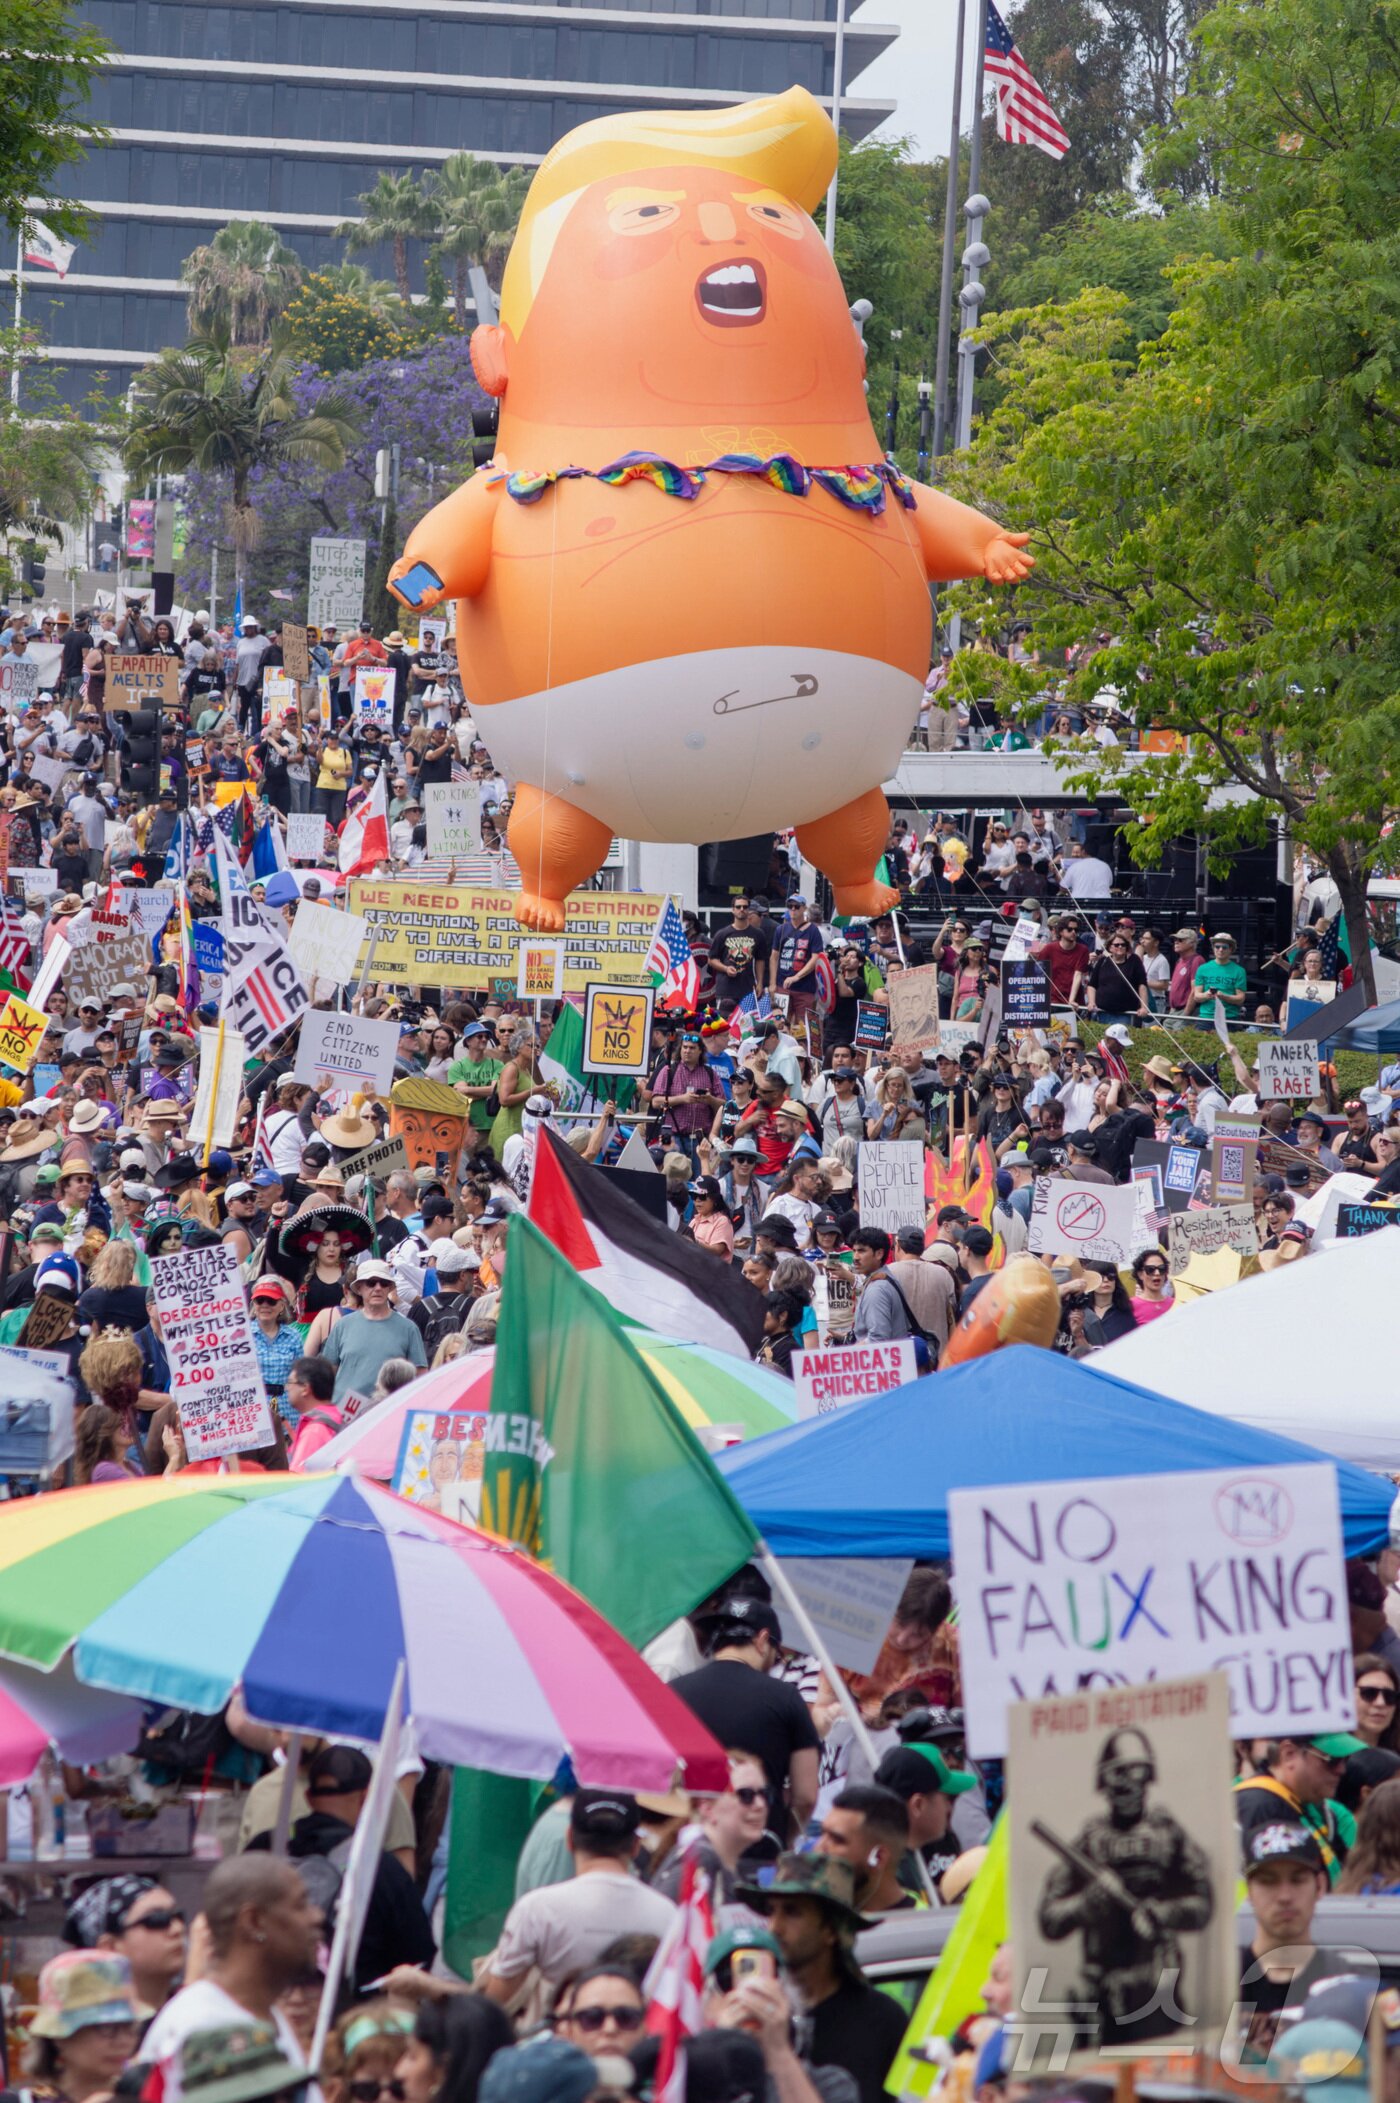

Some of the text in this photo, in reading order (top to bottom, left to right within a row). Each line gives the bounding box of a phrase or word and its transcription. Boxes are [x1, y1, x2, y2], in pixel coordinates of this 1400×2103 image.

[334, 606, 361, 619] pour
[13, 663, 39, 672] KINGS
[110, 656, 172, 672] EMPATHY
[13, 680, 34, 689] WAR
[14, 671, 39, 680] TRUMP
[112, 674, 164, 687] MELTS
[432, 787, 477, 801] NO KINGS
[443, 829, 471, 839] LOCK
[434, 841, 474, 852] HIM UP
[360, 890, 660, 916] WE NEED AND DEMAND
[91, 910, 128, 928] HANDS
[364, 909, 479, 931] REVOLUTION,
[487, 917, 520, 932] FOR
[564, 920, 610, 935] HOLE
[195, 939, 220, 956] ERICA
[406, 930, 430, 945] TO
[437, 932, 481, 948] LIVE,
[488, 935, 501, 948] A
[61, 933, 149, 977] DEMOCRACY
[415, 949, 513, 967] DIFFERENT
[90, 968, 119, 985] NOT
[263, 947, 310, 1015] ICE
[526, 980, 553, 989] IRAN
[1008, 977, 1045, 985] OPERATION
[1203, 976, 1236, 985] RESIST
[1008, 993, 1045, 1003] EPSTEIN
[1004, 1012, 1049, 1020] DISTRACTION
[325, 1021, 353, 1034] END
[1, 1032, 26, 1055] NO
[322, 1036, 379, 1058] CITIZENS
[604, 1031, 631, 1049] NO
[320, 1052, 362, 1070] UNITED
[602, 1049, 630, 1060] KINGS
[1270, 1043, 1318, 1060] ANGER:
[1282, 1066, 1298, 1077] ALL
[1302, 1066, 1314, 1076] THE
[1273, 1077, 1313, 1095] RAGE
[341, 1138, 404, 1180] FREE PHOTO
[866, 1143, 914, 1162] WE THE
[1172, 1155, 1195, 1167] YOUR
[863, 1163, 919, 1187] PEOPLE
[1169, 1164, 1193, 1179] JAIL
[1168, 1176, 1192, 1187] TIME?
[863, 1186, 920, 1209] NOT THE
[1030, 1177, 1052, 1252] NO KINGS
[1343, 1205, 1390, 1226] THANK
[1174, 1212, 1222, 1238] Resisting
[1087, 1242, 1112, 1252] Since
[1189, 1230, 1241, 1249] AMERICAN
[151, 1246, 227, 1273] TARJETAS
[1091, 1250, 1119, 1261] 1776
[153, 1257, 238, 1287] GRATUITAS
[158, 1272, 230, 1300] CONOZCA
[828, 1280, 852, 1300] NGS
[182, 1288, 215, 1307] SUS
[36, 1303, 70, 1325] LOCK
[160, 1296, 244, 1325] DERECHOS
[32, 1318, 57, 1339] HIM
[165, 1311, 246, 1342] WHISTLES
[28, 1334, 46, 1347] UP
[179, 1341, 251, 1367] POSTERS
[802, 1346, 902, 1377] AMERICA'S
[174, 1366, 214, 1388] 2.00
[812, 1370, 902, 1400] CHICKENS
[204, 1383, 232, 1397] YOUR
[181, 1387, 257, 1413] CONTRIBUTION
[188, 1397, 255, 1420] HELPS MAKE
[182, 1403, 263, 1430] MORE POSTERS
[200, 1420, 222, 1434] BUY
[227, 1413, 258, 1427] MORE
[200, 1423, 254, 1444] WHISTLES
[980, 1497, 1117, 1574] NO
[980, 1566, 1171, 1659] FAUX
[1188, 1548, 1335, 1642] KING
[1031, 1703, 1090, 1739] PAID
[1096, 1683, 1208, 1726] AGITATOR
